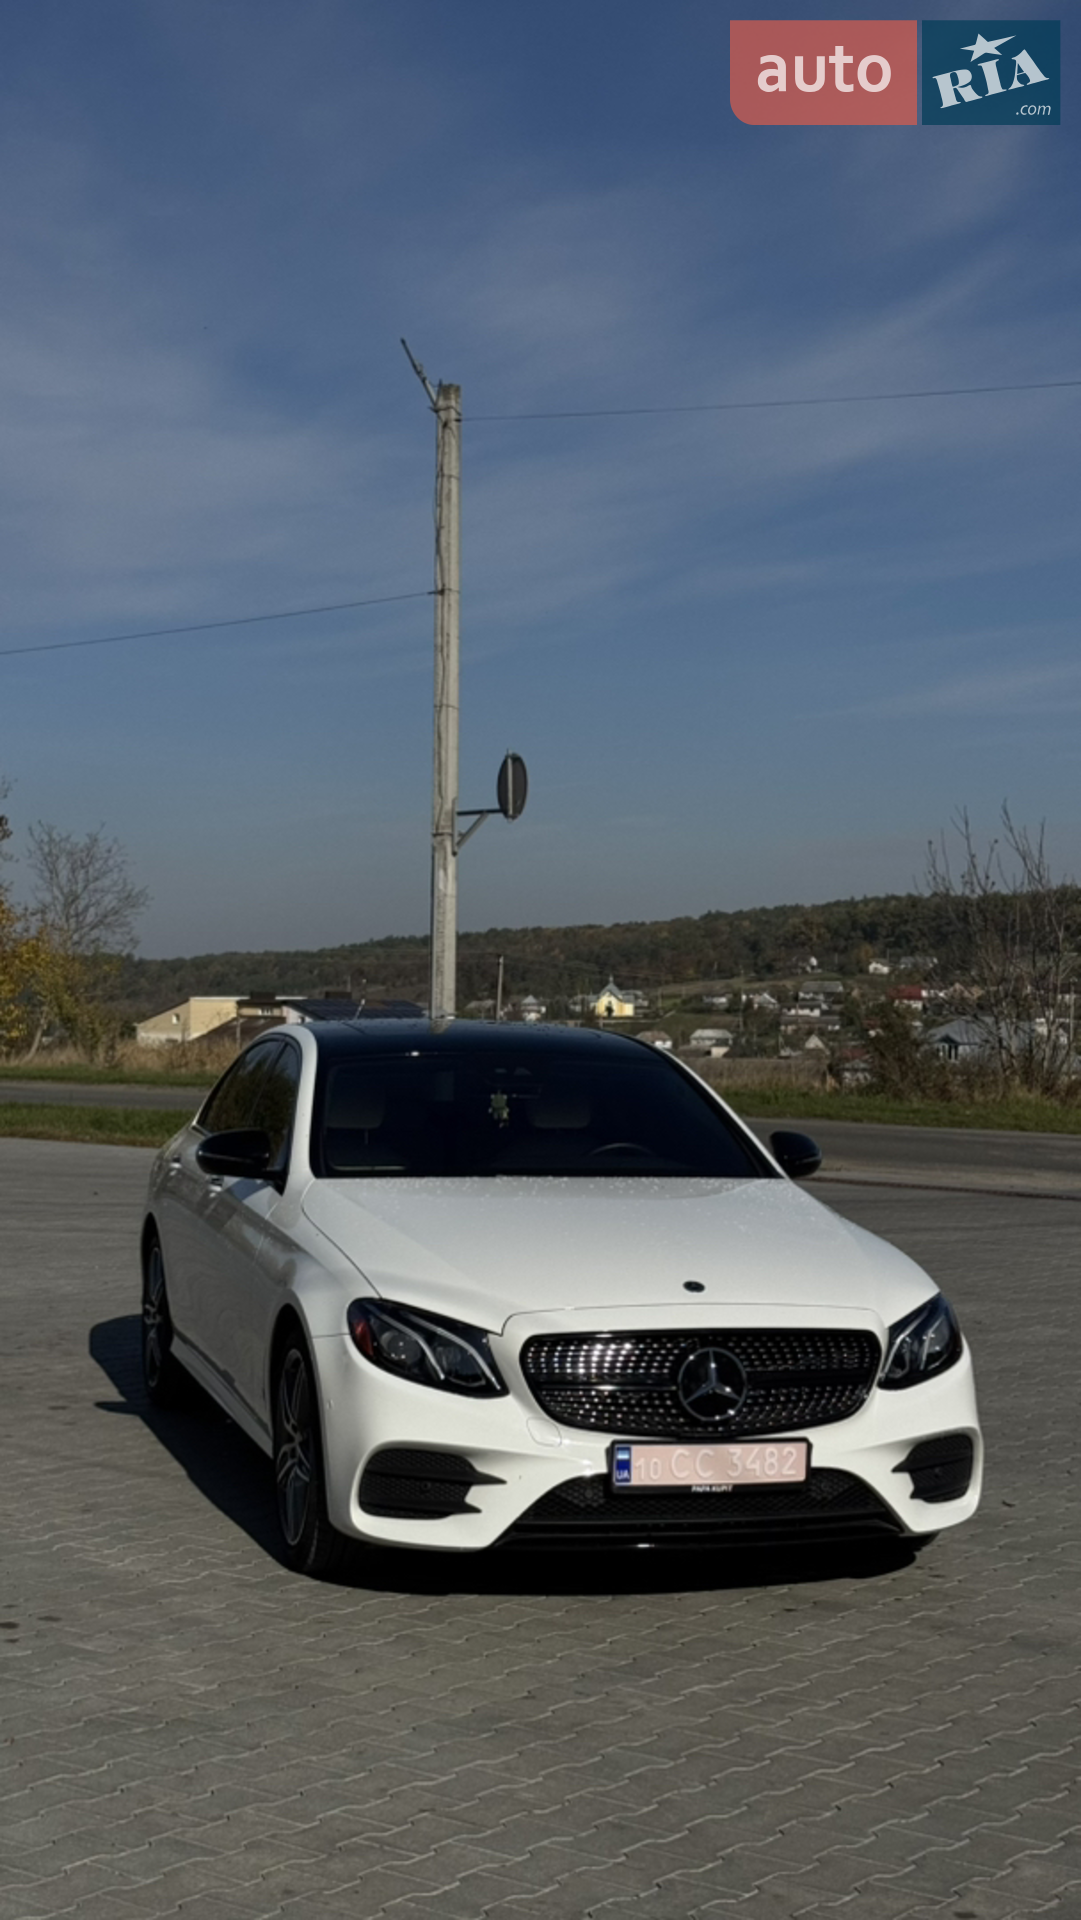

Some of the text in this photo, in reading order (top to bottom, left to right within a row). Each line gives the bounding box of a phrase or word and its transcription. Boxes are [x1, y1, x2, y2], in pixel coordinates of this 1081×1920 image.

[616, 1446, 798, 1480] UA 10 CC 3482
